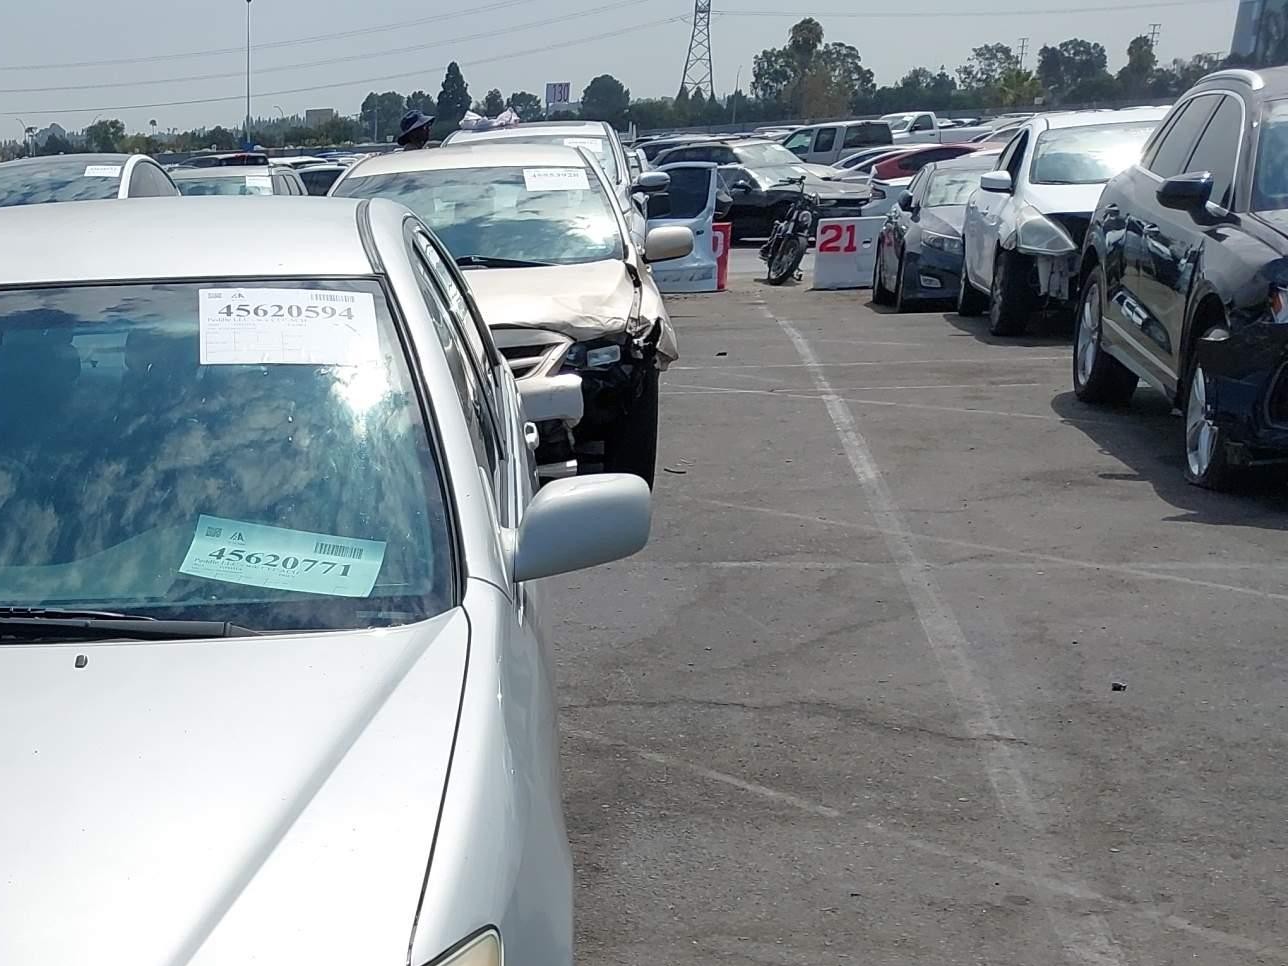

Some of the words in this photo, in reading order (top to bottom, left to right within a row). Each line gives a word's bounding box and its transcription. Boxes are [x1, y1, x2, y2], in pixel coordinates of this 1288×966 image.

[819, 224, 857, 253] 21
[218, 304, 355, 321] 45620594
[209, 547, 353, 577] 45620771
